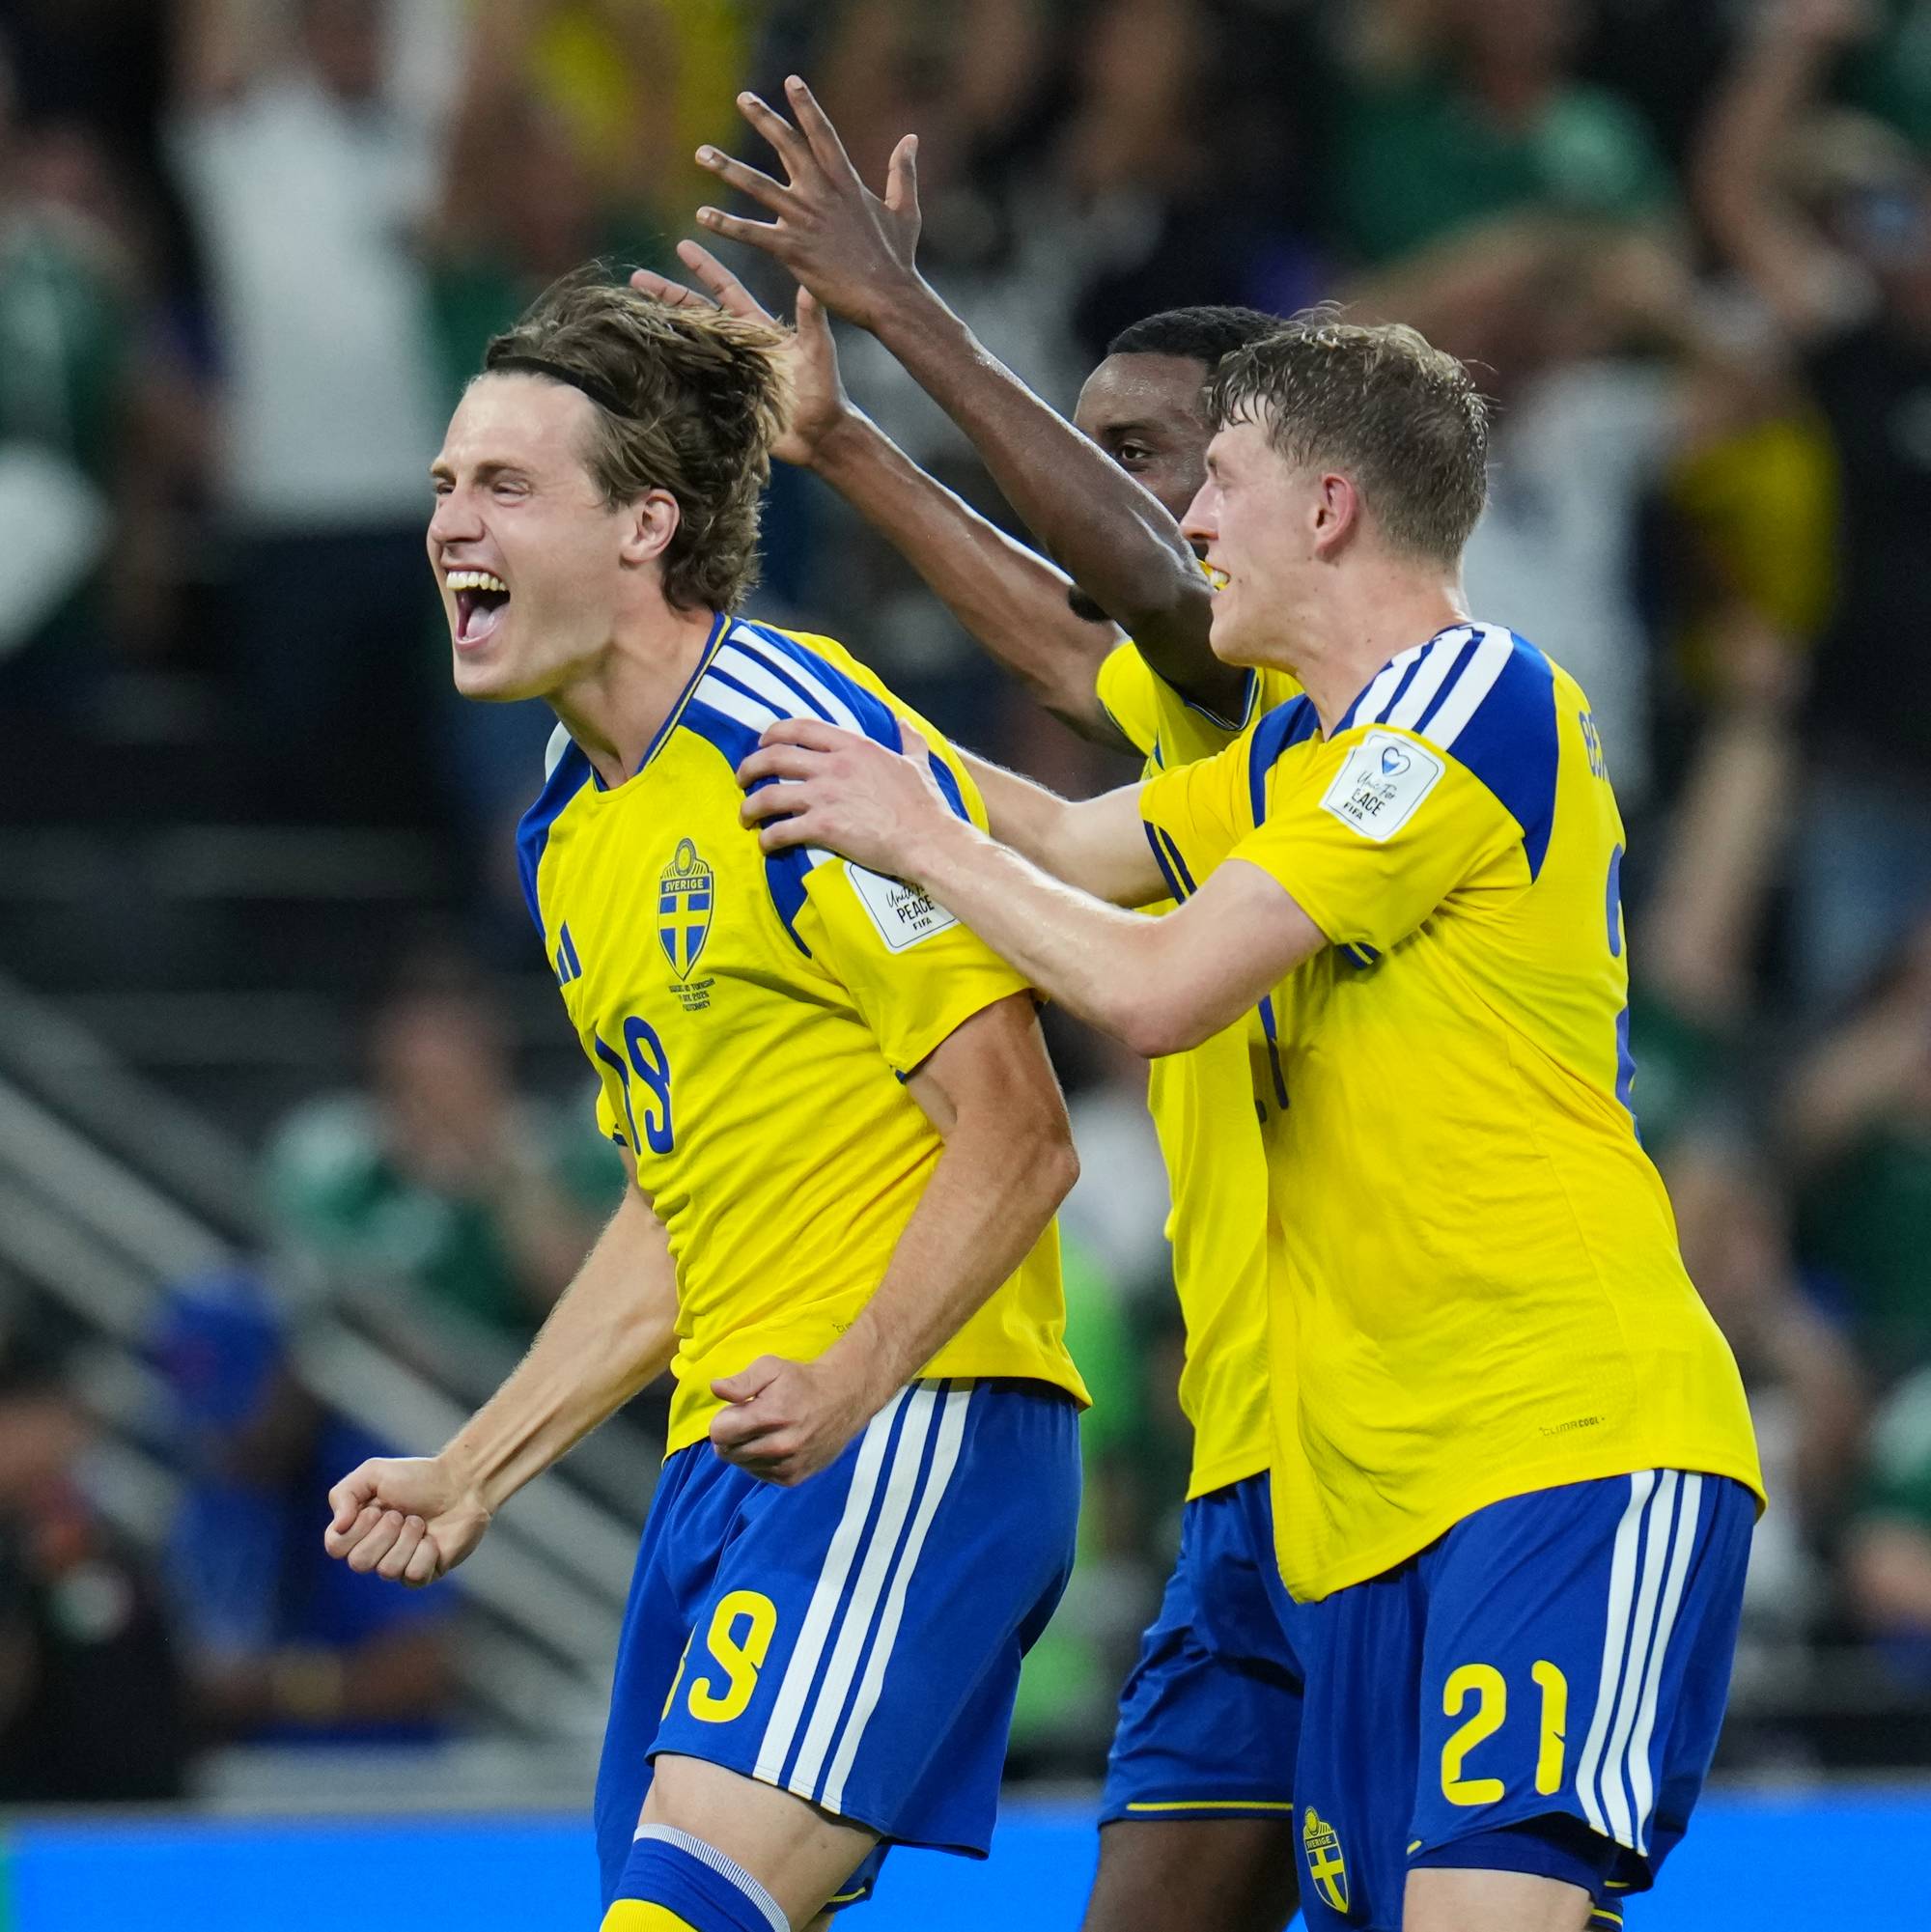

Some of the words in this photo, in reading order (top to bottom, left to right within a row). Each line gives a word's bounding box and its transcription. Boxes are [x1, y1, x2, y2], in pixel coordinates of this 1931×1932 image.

[1343, 801, 1363, 820] FIFA
[1351, 787, 1385, 817] EACE
[664, 878, 705, 893] SVERIGE
[896, 894, 936, 924] PEACE
[912, 916, 933, 931] FIFA
[1441, 1659, 1569, 1806] 21
